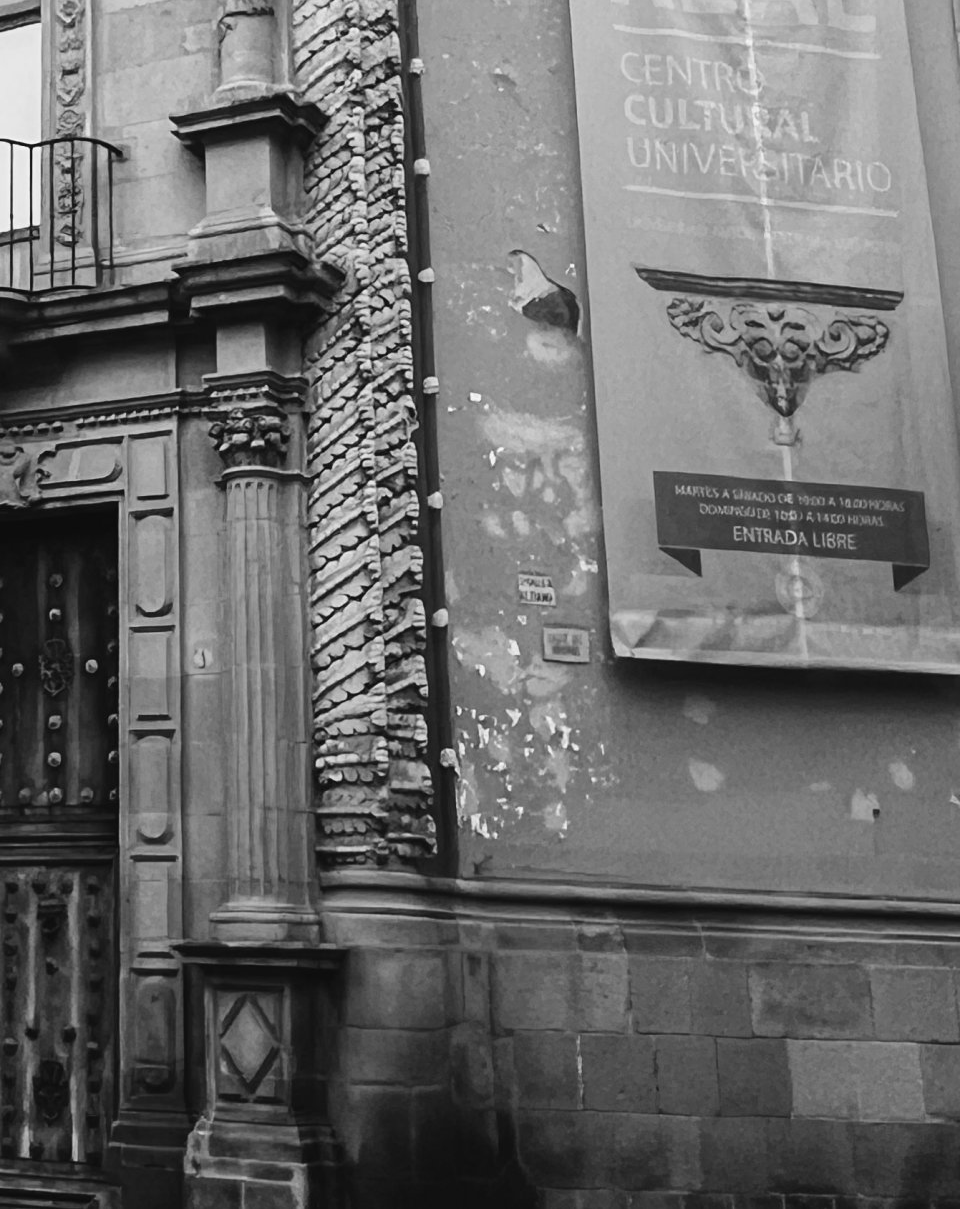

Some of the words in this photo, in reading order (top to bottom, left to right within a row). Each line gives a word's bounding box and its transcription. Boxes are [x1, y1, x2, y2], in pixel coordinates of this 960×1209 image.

[620, 52, 766, 95] CENTRO
[624, 94, 820, 143] CULTURAL
[627, 136, 892, 192] UNIVERSITARIO
[674, 484, 720, 499] MARTES
[722, 488, 730, 499] A
[777, 493, 794, 504] DE
[828, 496, 836, 507] A
[732, 526, 809, 548] ENTRADA
[812, 531, 858, 550] LIBRE
